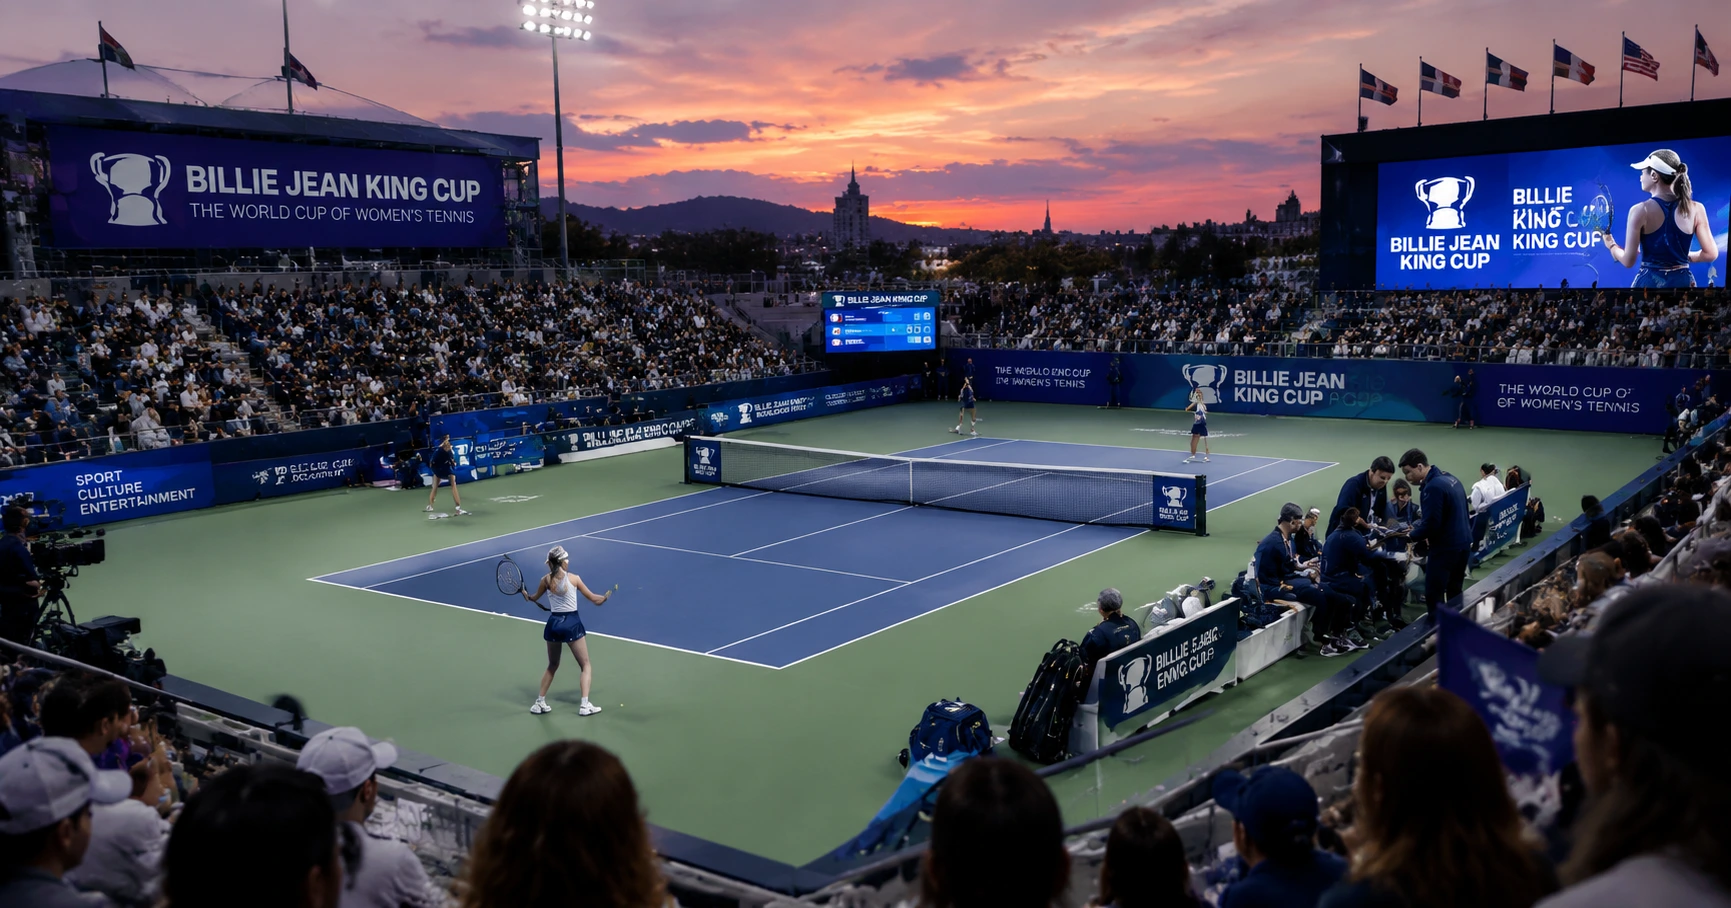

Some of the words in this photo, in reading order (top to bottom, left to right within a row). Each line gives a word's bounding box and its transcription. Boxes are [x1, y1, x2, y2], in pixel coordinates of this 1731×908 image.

[186, 165, 279, 196] BILLIE
[286, 170, 359, 198] JEAN
[365, 174, 428, 201] KING
[432, 178, 480, 202] CUP
[189, 202, 224, 218] THE
[229, 204, 290, 220] WORLD
[294, 205, 326, 220] CUP
[331, 206, 350, 220] OF
[354, 208, 422, 222] WOMEN'S
[426, 210, 474, 223] TENNIS
[1390, 236, 1445, 252] BILLIE
[1449, 234, 1500, 251] JEAN
[1513, 232, 1558, 250] KING
[1400, 254, 1445, 270] KING
[1450, 253, 1490, 269] CUP
[1234, 370, 1289, 387] BILLIE
[1294, 372, 1345, 389] JEAN
[1234, 387, 1279, 404] KING
[1283, 390, 1323, 405] CUP
[1499, 384, 1524, 394] THE
[1529, 385, 1578, 397] WORLD
[1583, 387, 1611, 398] CUP
[1521, 398, 1582, 411] WOMEN'S
[76, 470, 123, 486] SPORT
[78, 482, 143, 500] CULTURE
